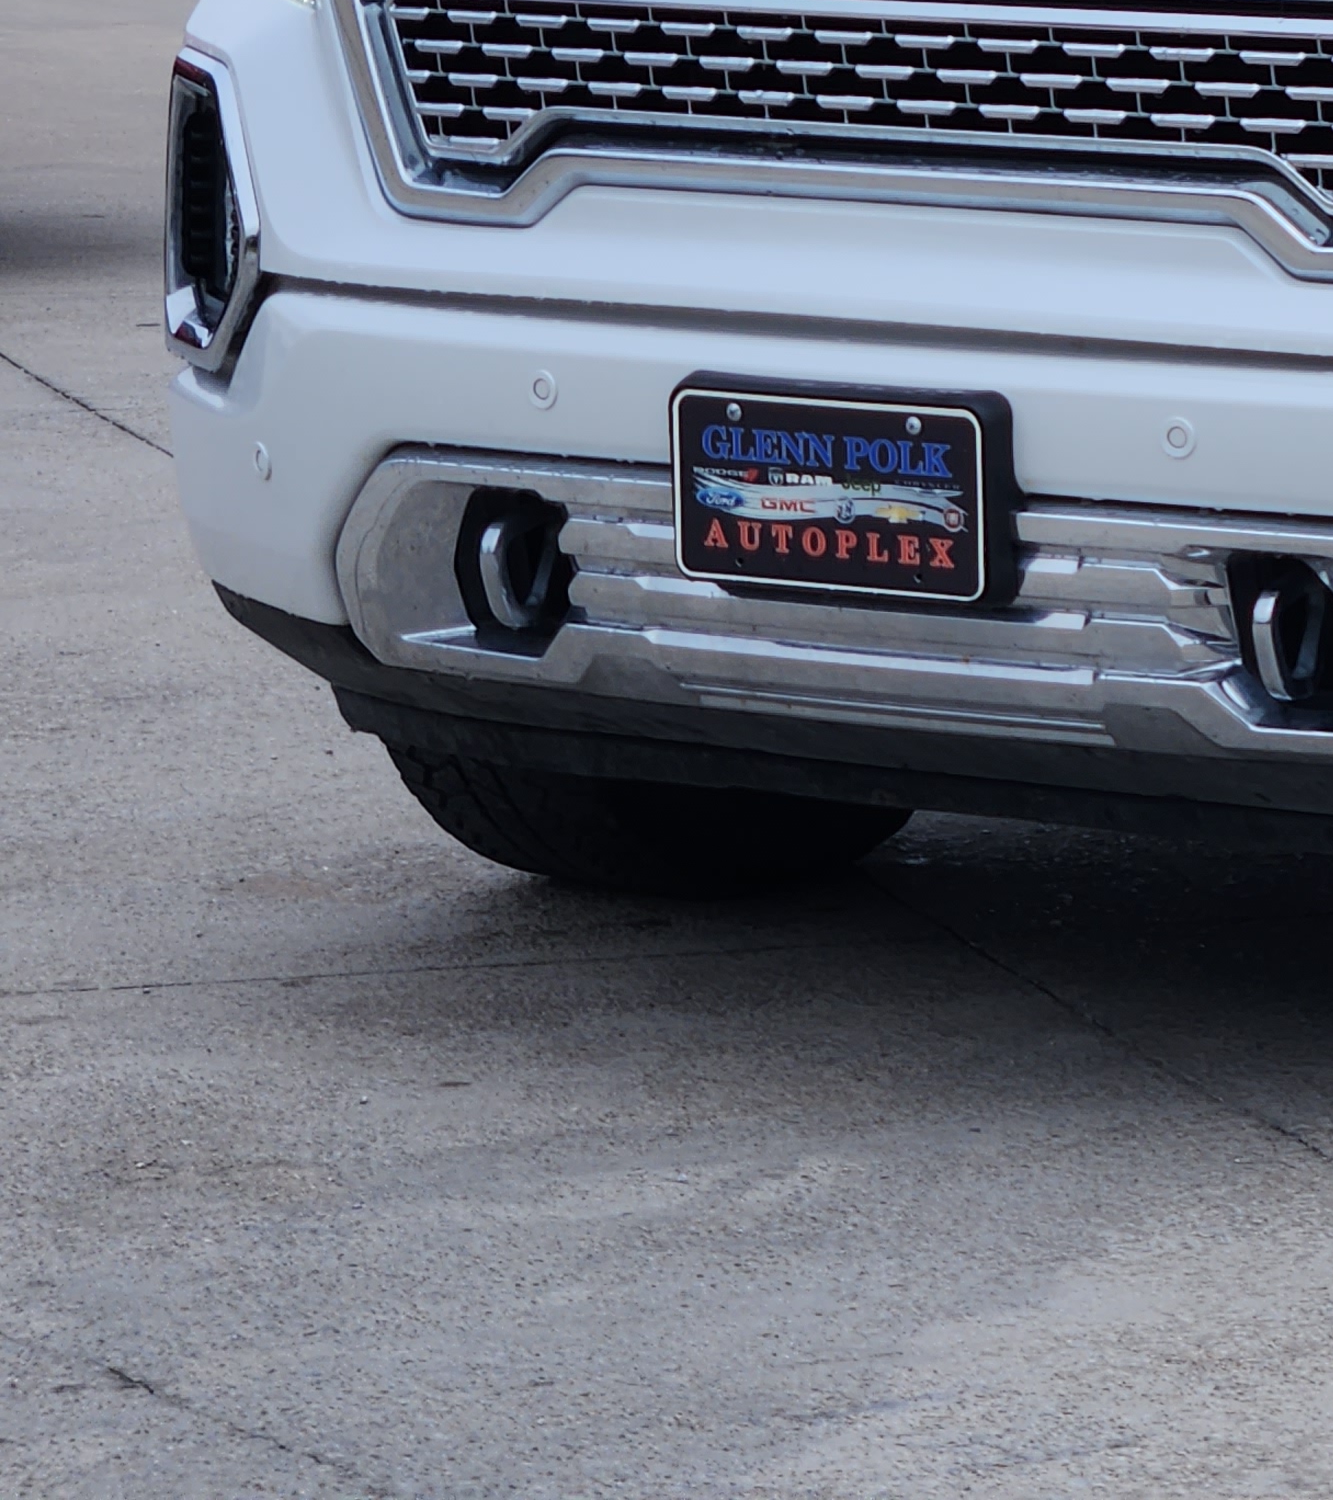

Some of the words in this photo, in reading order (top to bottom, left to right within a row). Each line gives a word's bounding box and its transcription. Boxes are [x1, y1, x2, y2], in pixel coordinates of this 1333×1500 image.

[702, 424, 835, 468] GLENN
[844, 434, 952, 478] POLK
[693, 466, 749, 478] DODGE
[785, 472, 833, 486] RAM
[705, 491, 736, 506] Ford
[761, 498, 816, 514] GMC
[704, 518, 954, 569] AUTOPLEX
